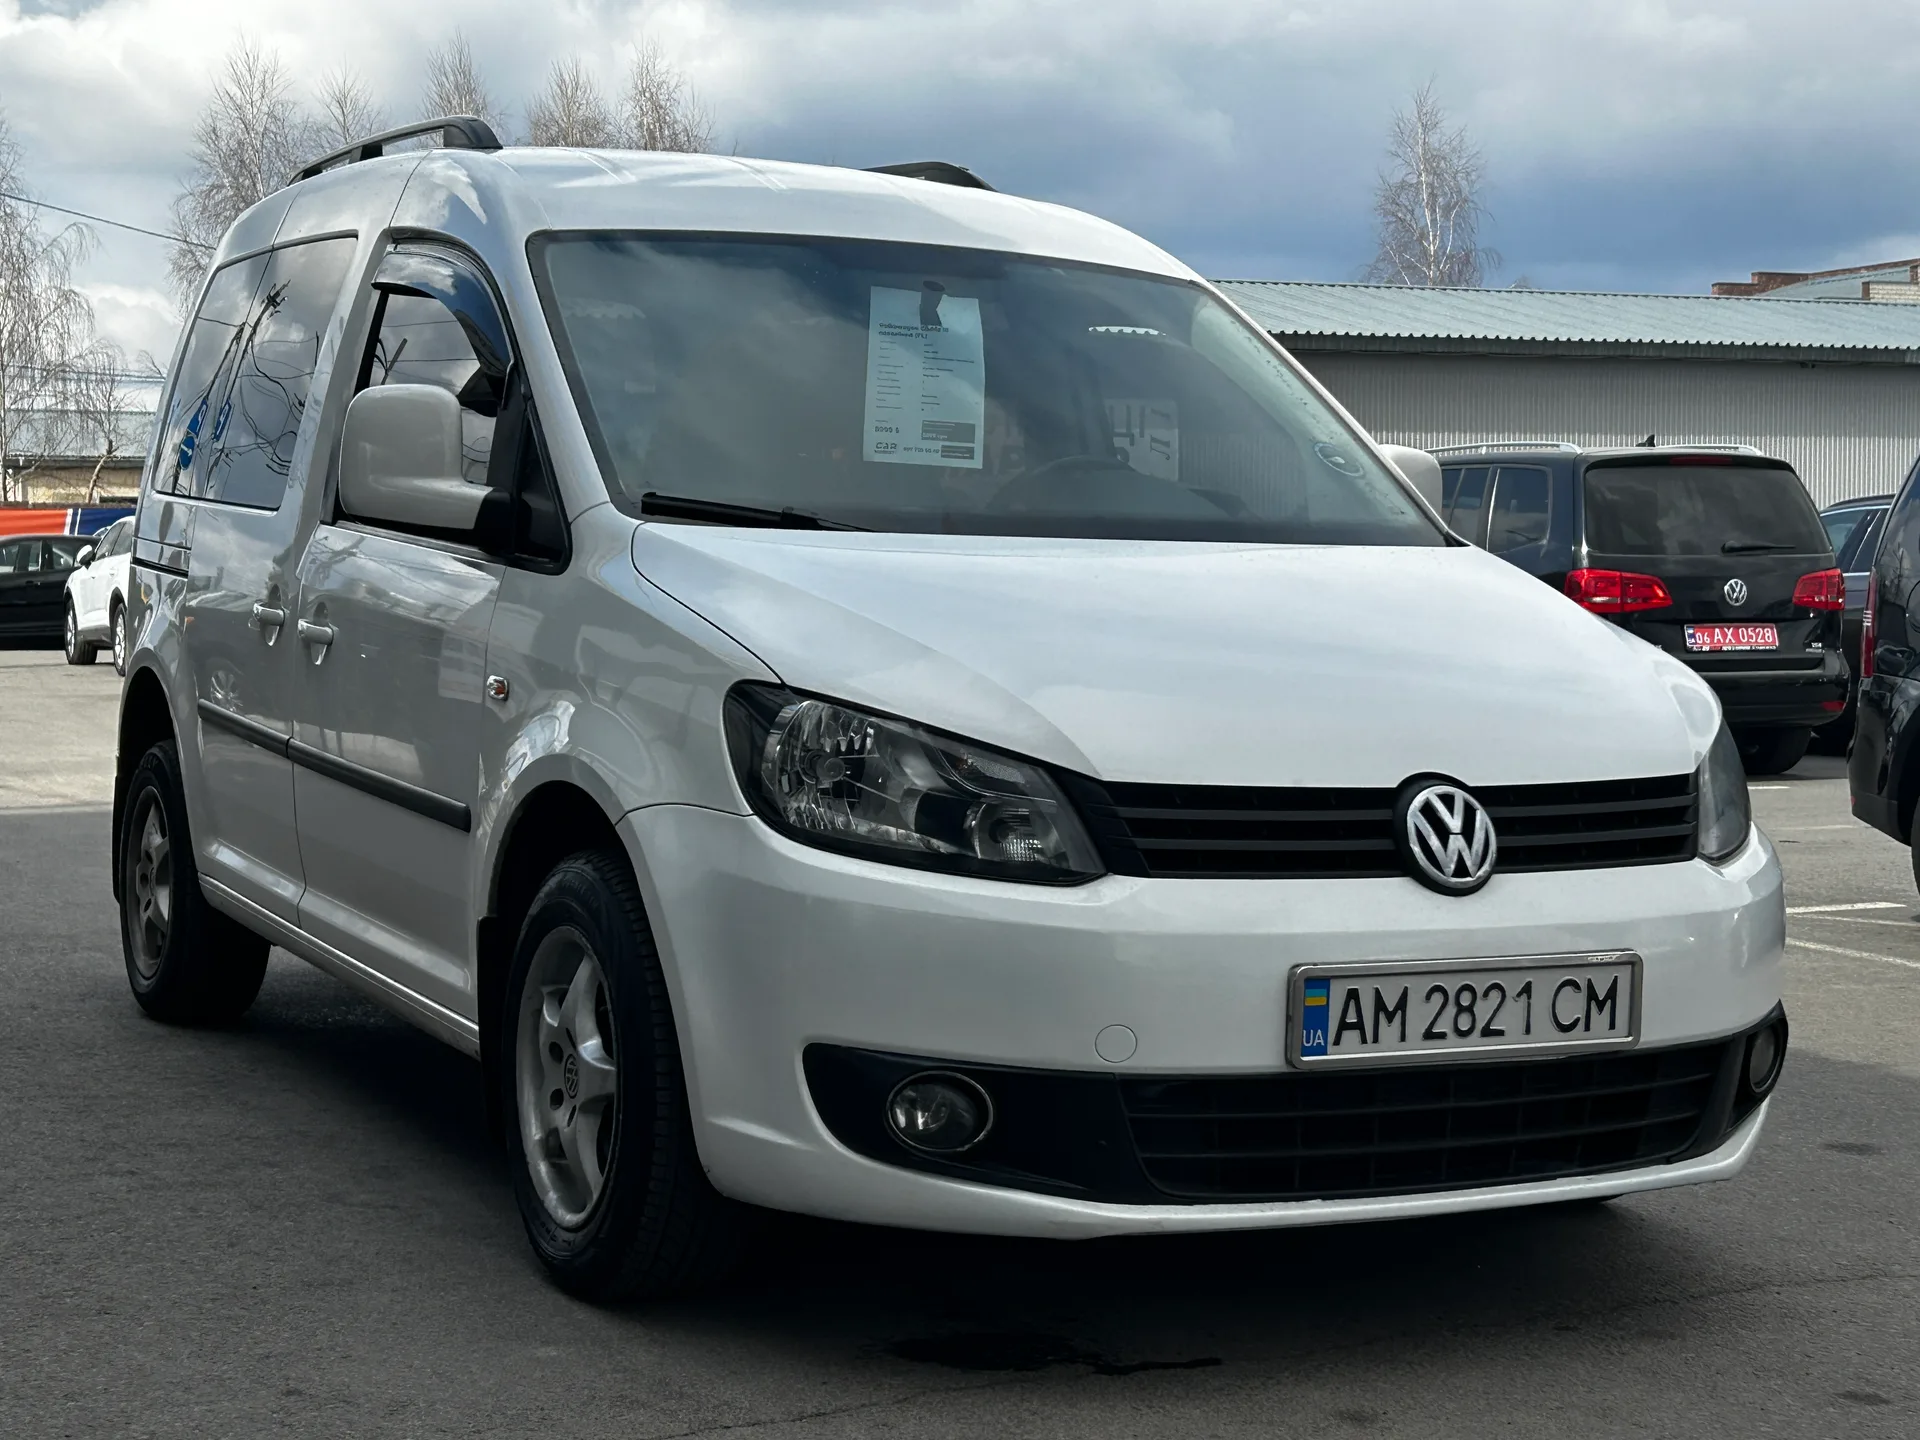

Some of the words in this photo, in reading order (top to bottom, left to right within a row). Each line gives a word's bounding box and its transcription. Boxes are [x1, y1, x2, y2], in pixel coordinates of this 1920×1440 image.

[1696, 632, 1710, 644] 06
[1713, 627, 1735, 644] AX
[1738, 627, 1773, 643] 0528
[1302, 1029, 1325, 1047] UA
[1332, 985, 1409, 1046] AM
[1421, 978, 1533, 1041] 2821
[1550, 974, 1620, 1034] CM
